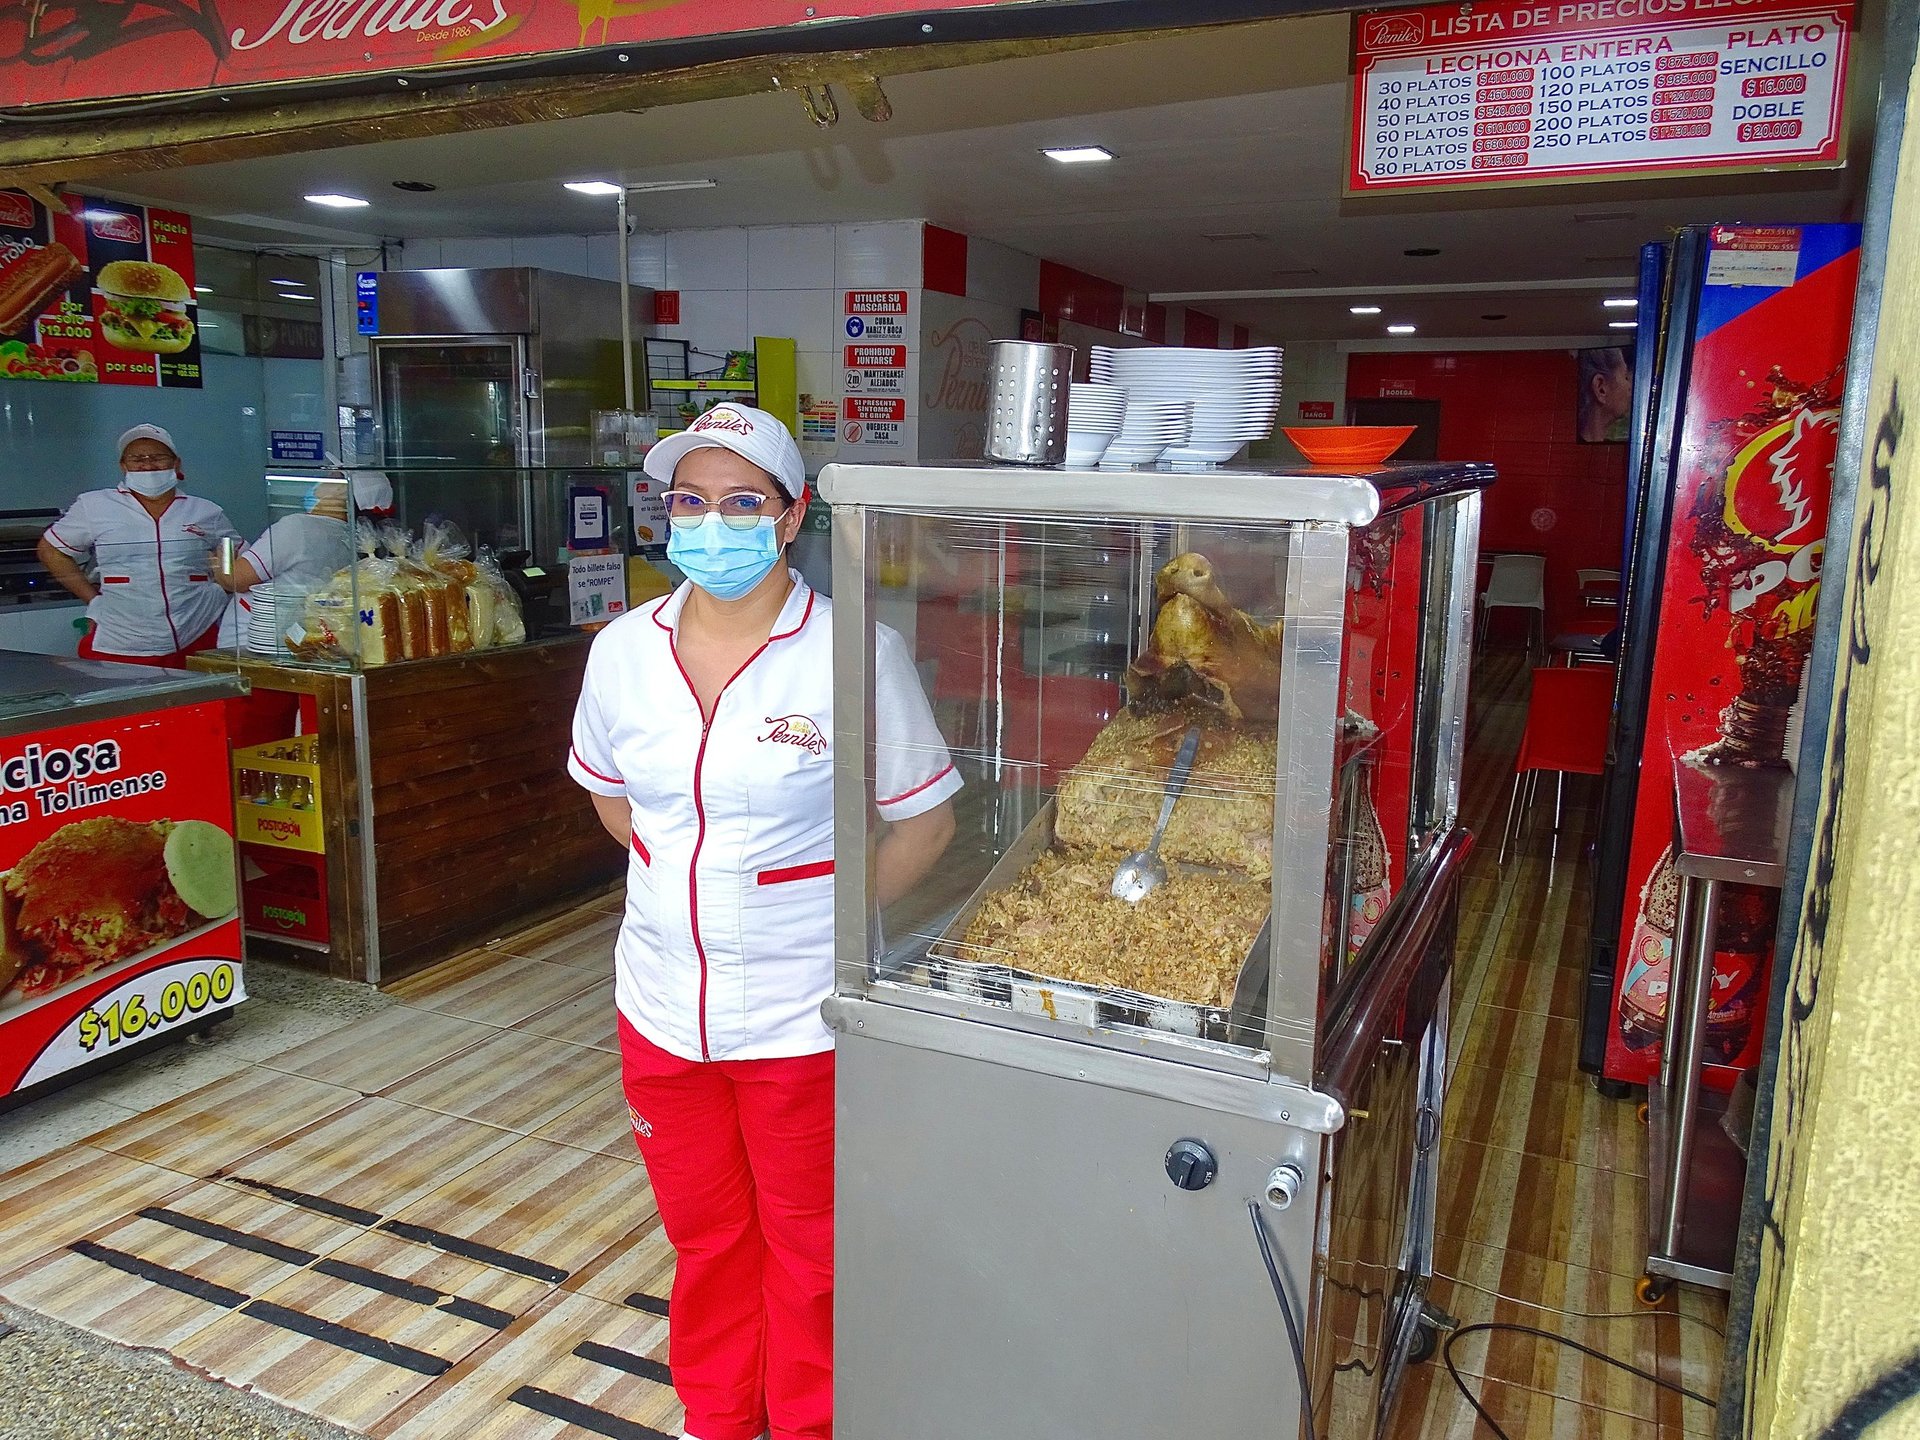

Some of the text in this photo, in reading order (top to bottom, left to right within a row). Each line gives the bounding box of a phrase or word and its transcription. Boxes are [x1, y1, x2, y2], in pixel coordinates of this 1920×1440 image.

[1431, 0, 1687, 38] LISTA DE PRECIOS
[416, 26, 471, 43] Desde 1986
[1367, 18, 1421, 45] Perniles
[1727, 24, 1825, 49] PLATO
[1426, 36, 1673, 75] LECHONA ENTERA
[1720, 52, 1827, 75] SENCILLO
[1541, 66, 1575, 80] 100
[1580, 61, 1651, 77] PLATOS
[1378, 82, 1402, 94] 30
[1406, 77, 1472, 93] PLATOS
[1540, 83, 1573, 97] 120
[1579, 78, 1649, 94] PLATOS
[1377, 98, 1401, 110] 40
[1405, 94, 1471, 109] PLATOS
[1539, 100, 1572, 114] 150
[1578, 96, 1648, 111] PLATOS
[1732, 101, 1804, 120] DOBLE
[1376, 114, 1400, 127] 50
[1404, 110, 1470, 125] PLATOS
[1534, 117, 1572, 132] 200
[1577, 113, 1648, 128] PLATOS
[1376, 130, 1399, 143] 60
[1404, 127, 1469, 142] PLATOS
[1533, 134, 1571, 148] 250
[1576, 130, 1646, 145] PLATOS
[1375, 147, 1398, 160] 70
[1403, 143, 1468, 158] PLATOS
[1374, 163, 1398, 175] 80
[1402, 159, 1467, 174] PLATOS
[855, 293, 900, 303] UTILICE SU
[853, 303, 901, 312] MASCARILA
[874, 317, 894, 325] CUBRA
[39, 324, 92, 337] $12.000
[854, 347, 896, 356] PROHIBIDO
[106, 361, 155, 374] por solo
[857, 356, 893, 365] JUNTARSE
[864, 370, 904, 378] MANTENGANSE
[870, 379, 897, 387] ALEJADOS
[693, 411, 754, 436] Perniles
[891, 423, 898, 431] EN
[572, 562, 621, 574] Todo billete falso
[757, 717, 827, 755] Perniles
[36, 771, 166, 816] Tolimense
[79, 963, 235, 1052] $16.000
